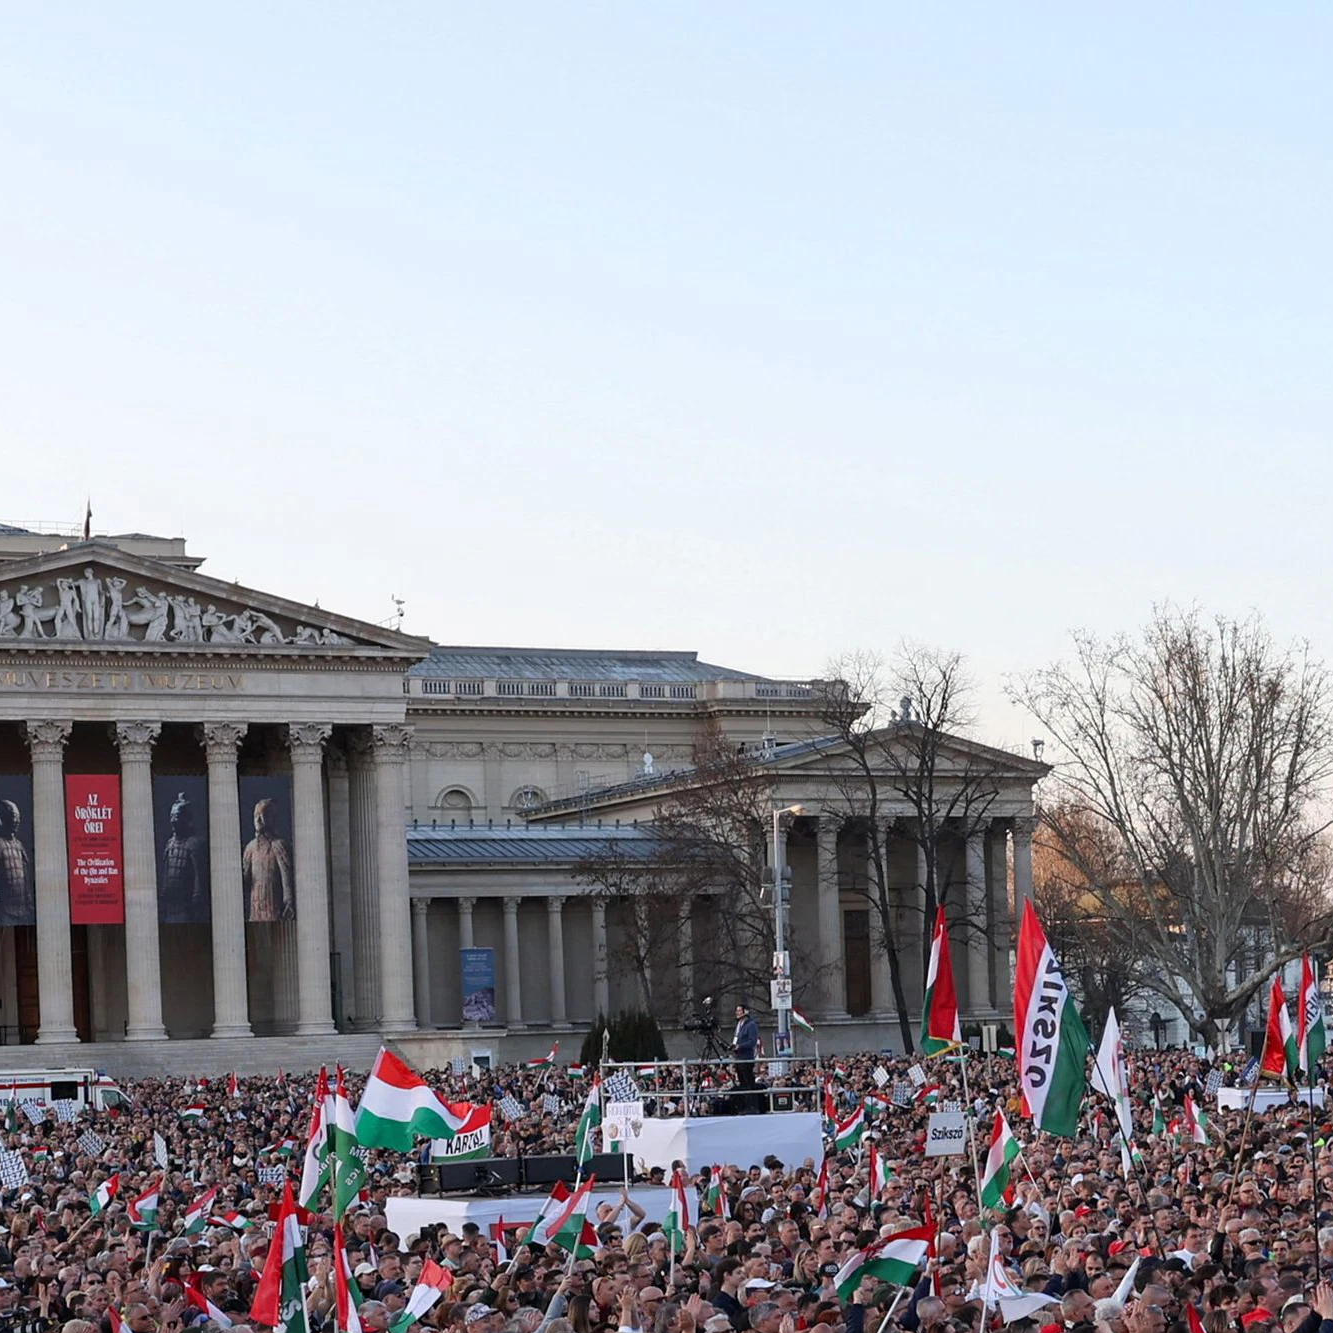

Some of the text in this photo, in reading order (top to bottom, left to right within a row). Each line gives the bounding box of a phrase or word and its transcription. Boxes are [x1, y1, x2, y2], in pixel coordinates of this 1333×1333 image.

[87, 793, 98, 806] AZ
[77, 858, 114, 867] The Civilization
[84, 877, 109, 886] Dynasties
[931, 1125, 963, 1141] Szikszó
